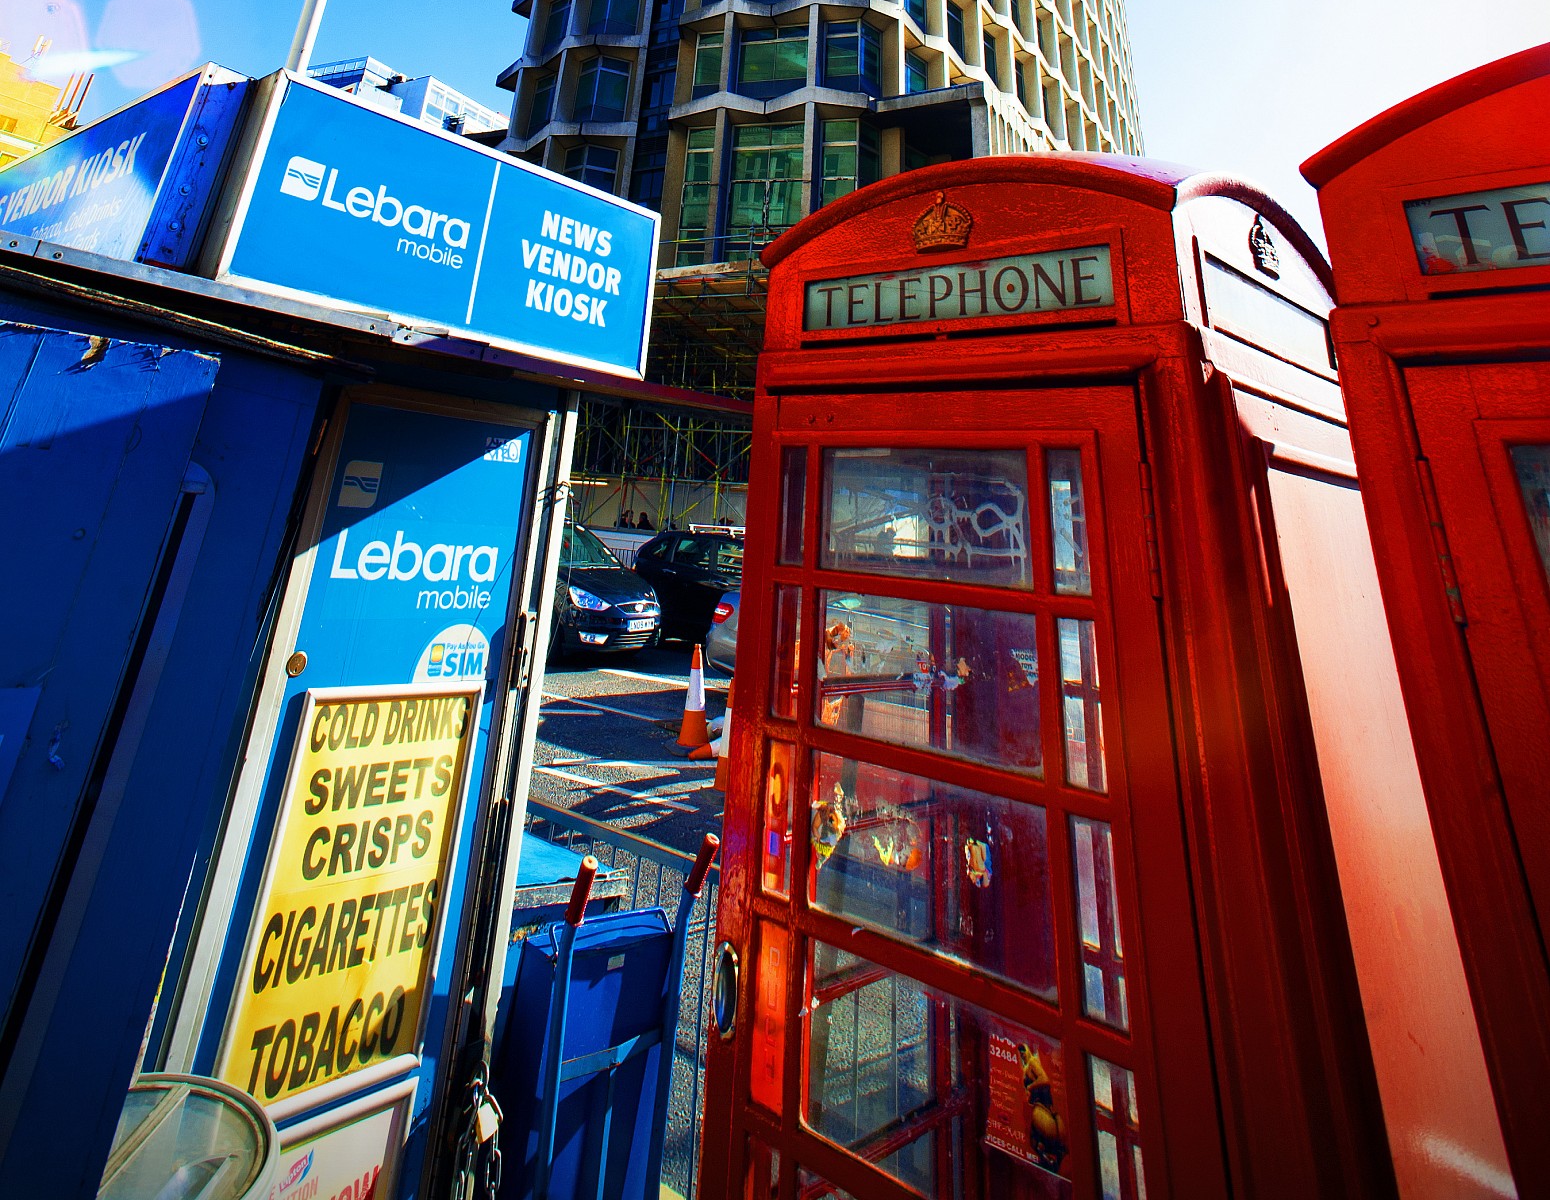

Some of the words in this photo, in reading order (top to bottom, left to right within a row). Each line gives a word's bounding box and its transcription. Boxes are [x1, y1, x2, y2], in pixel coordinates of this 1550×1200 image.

[2, 165, 76, 225] VENDOR
[69, 132, 147, 198] KIOSK
[322, 168, 471, 249] Lebara
[541, 210, 612, 257] NEWS
[396, 238, 463, 269] mobile
[522, 239, 621, 296] VENDOR
[525, 279, 607, 327] KIOSK
[817, 256, 1102, 327] TELEPHONE
[330, 528, 498, 582] Lebara
[416, 585, 491, 609] mobile
[443, 652, 483, 677] SIM
[446, 643, 457, 651] Pay
[311, 703, 379, 753] COLD
[383, 697, 470, 746] DRINKS
[304, 754, 453, 815] SWEETS
[302, 810, 434, 880] CRISPS
[253, 879, 437, 994] CIGARETTES
[248, 985, 405, 1099] TOBACCO
